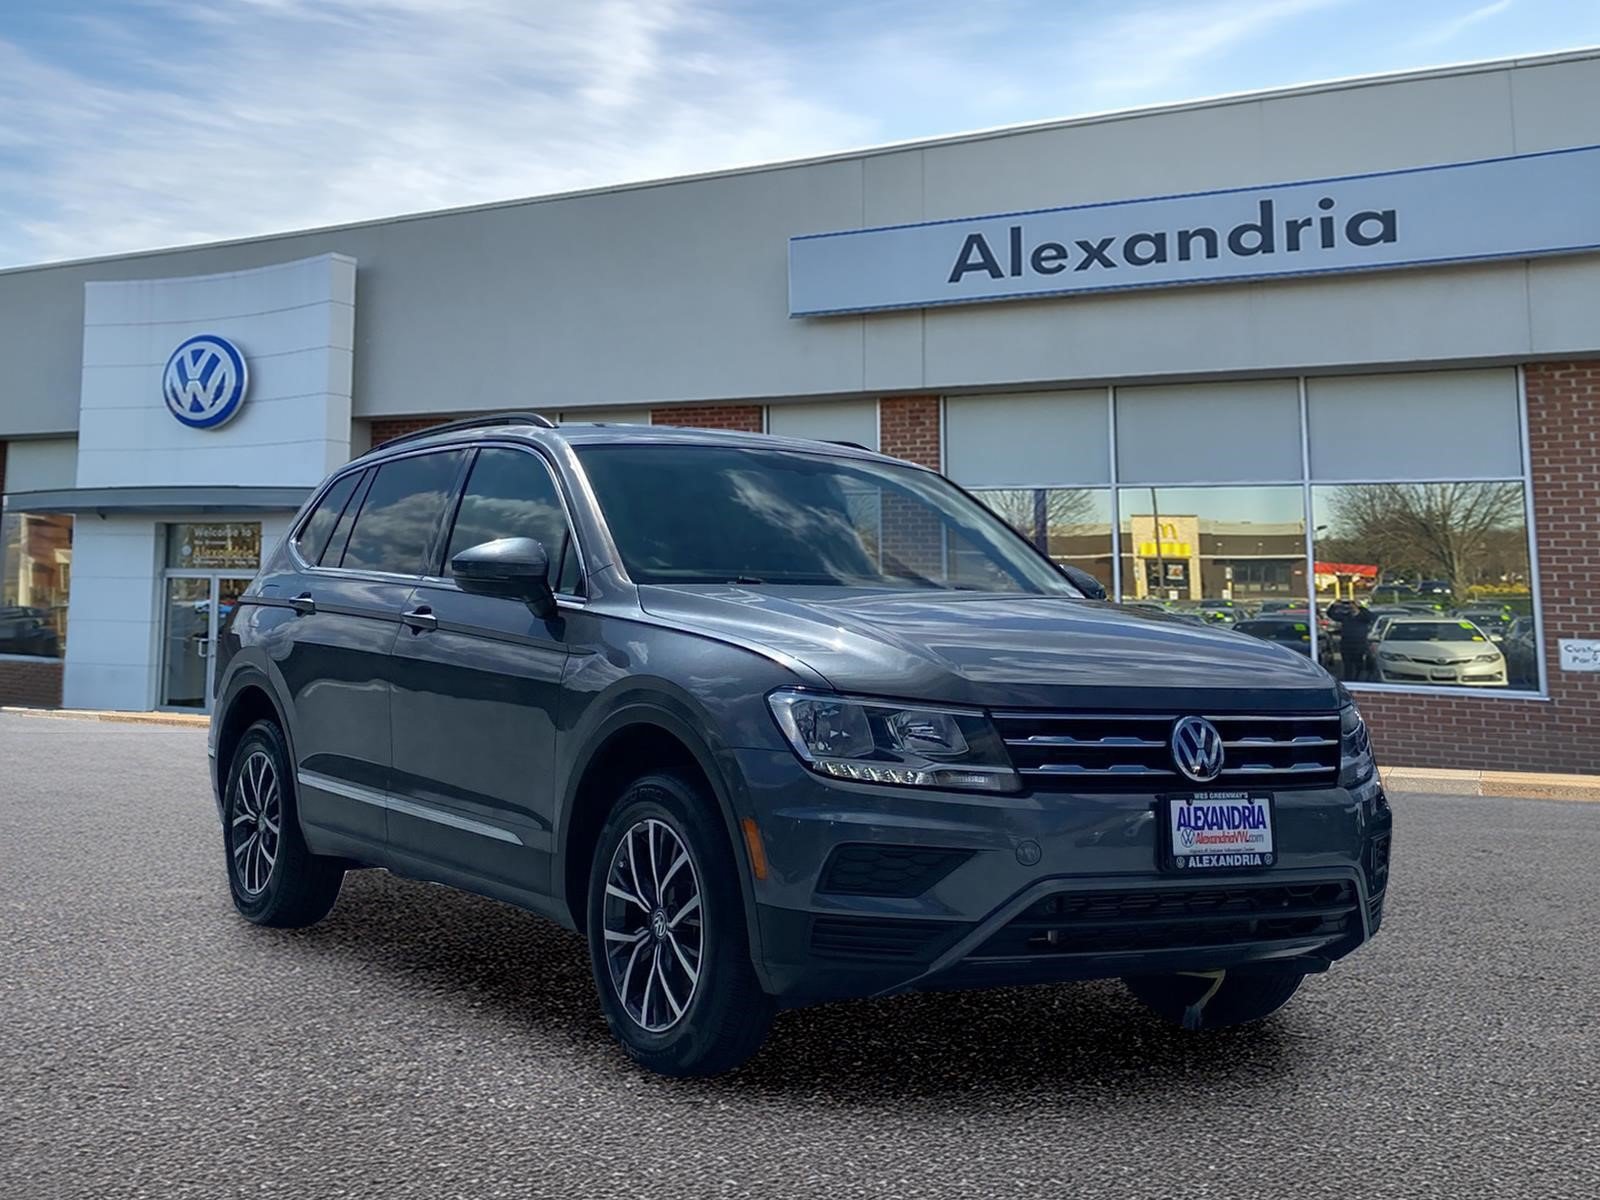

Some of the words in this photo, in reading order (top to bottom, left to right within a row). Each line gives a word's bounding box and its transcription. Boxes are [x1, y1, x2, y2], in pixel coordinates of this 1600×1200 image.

[948, 197, 1398, 284] Alexandria
[1177, 805, 1267, 831] ALEXANDRIA
[1188, 854, 1262, 868] ALEXANDRIA
